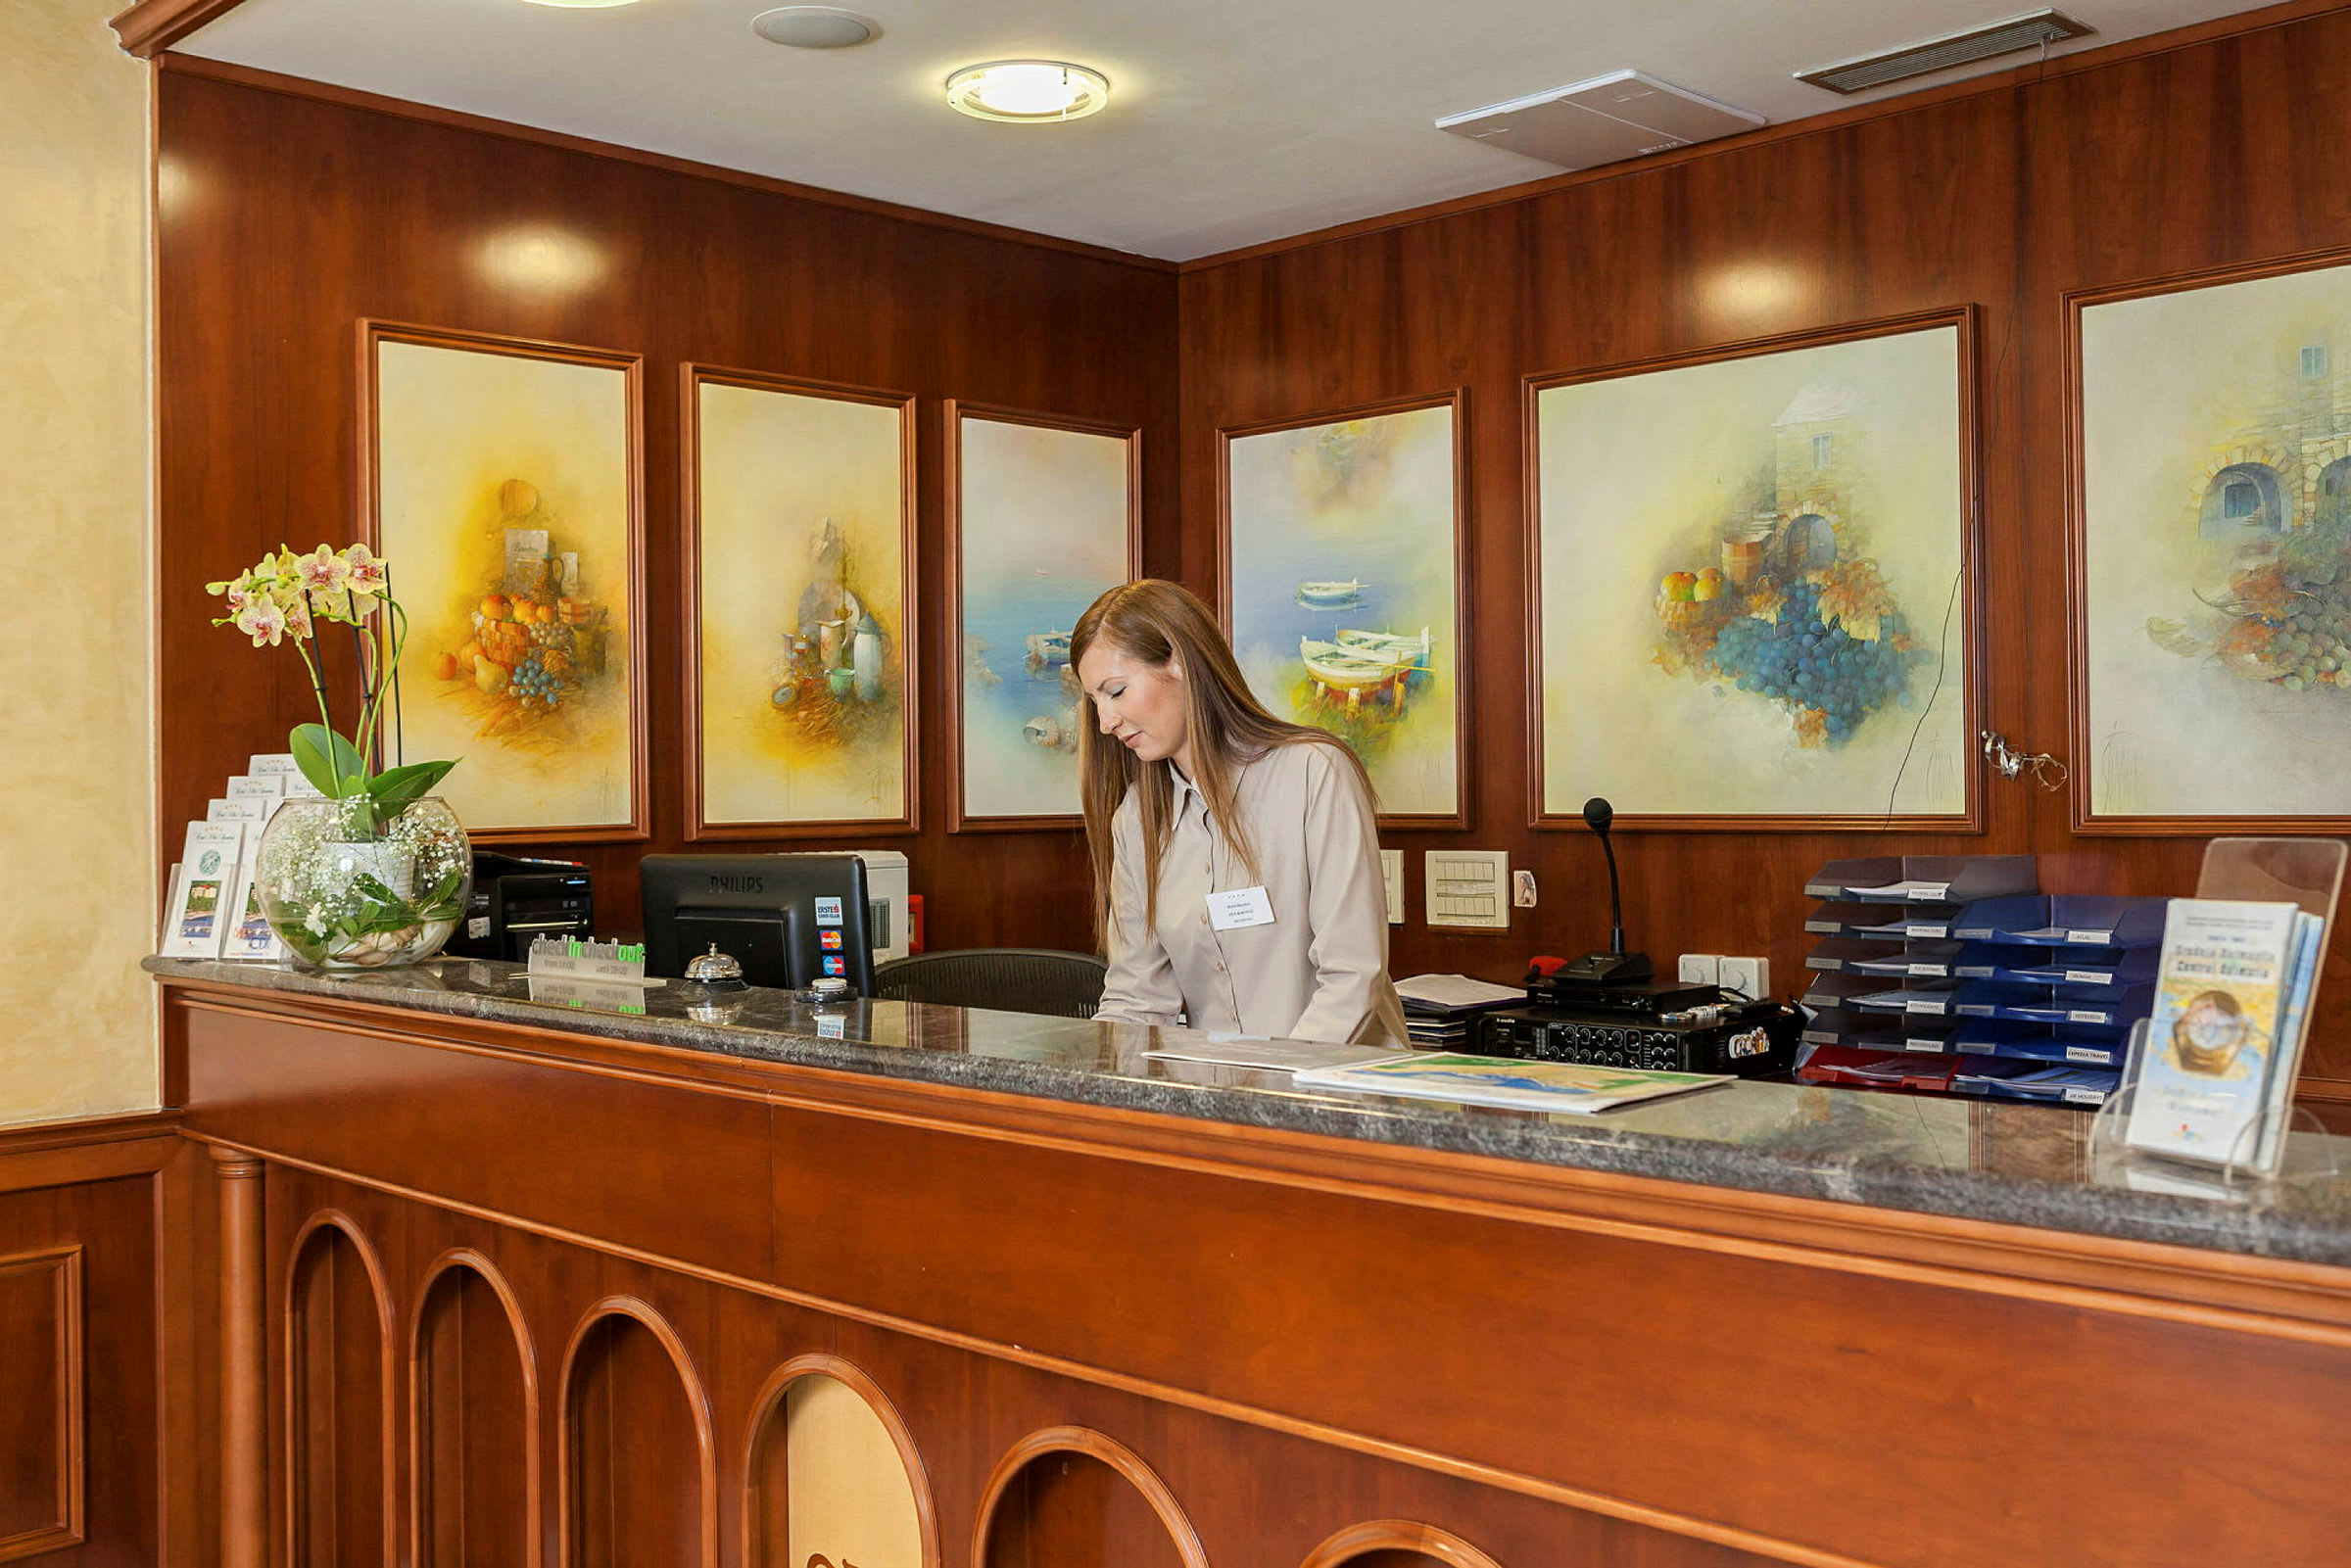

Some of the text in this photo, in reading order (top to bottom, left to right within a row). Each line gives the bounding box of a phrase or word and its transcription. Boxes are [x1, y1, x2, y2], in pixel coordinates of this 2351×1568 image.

[710, 876, 764, 892] PHILIPS
[568, 935, 582, 959] in
[618, 943, 645, 963] out
